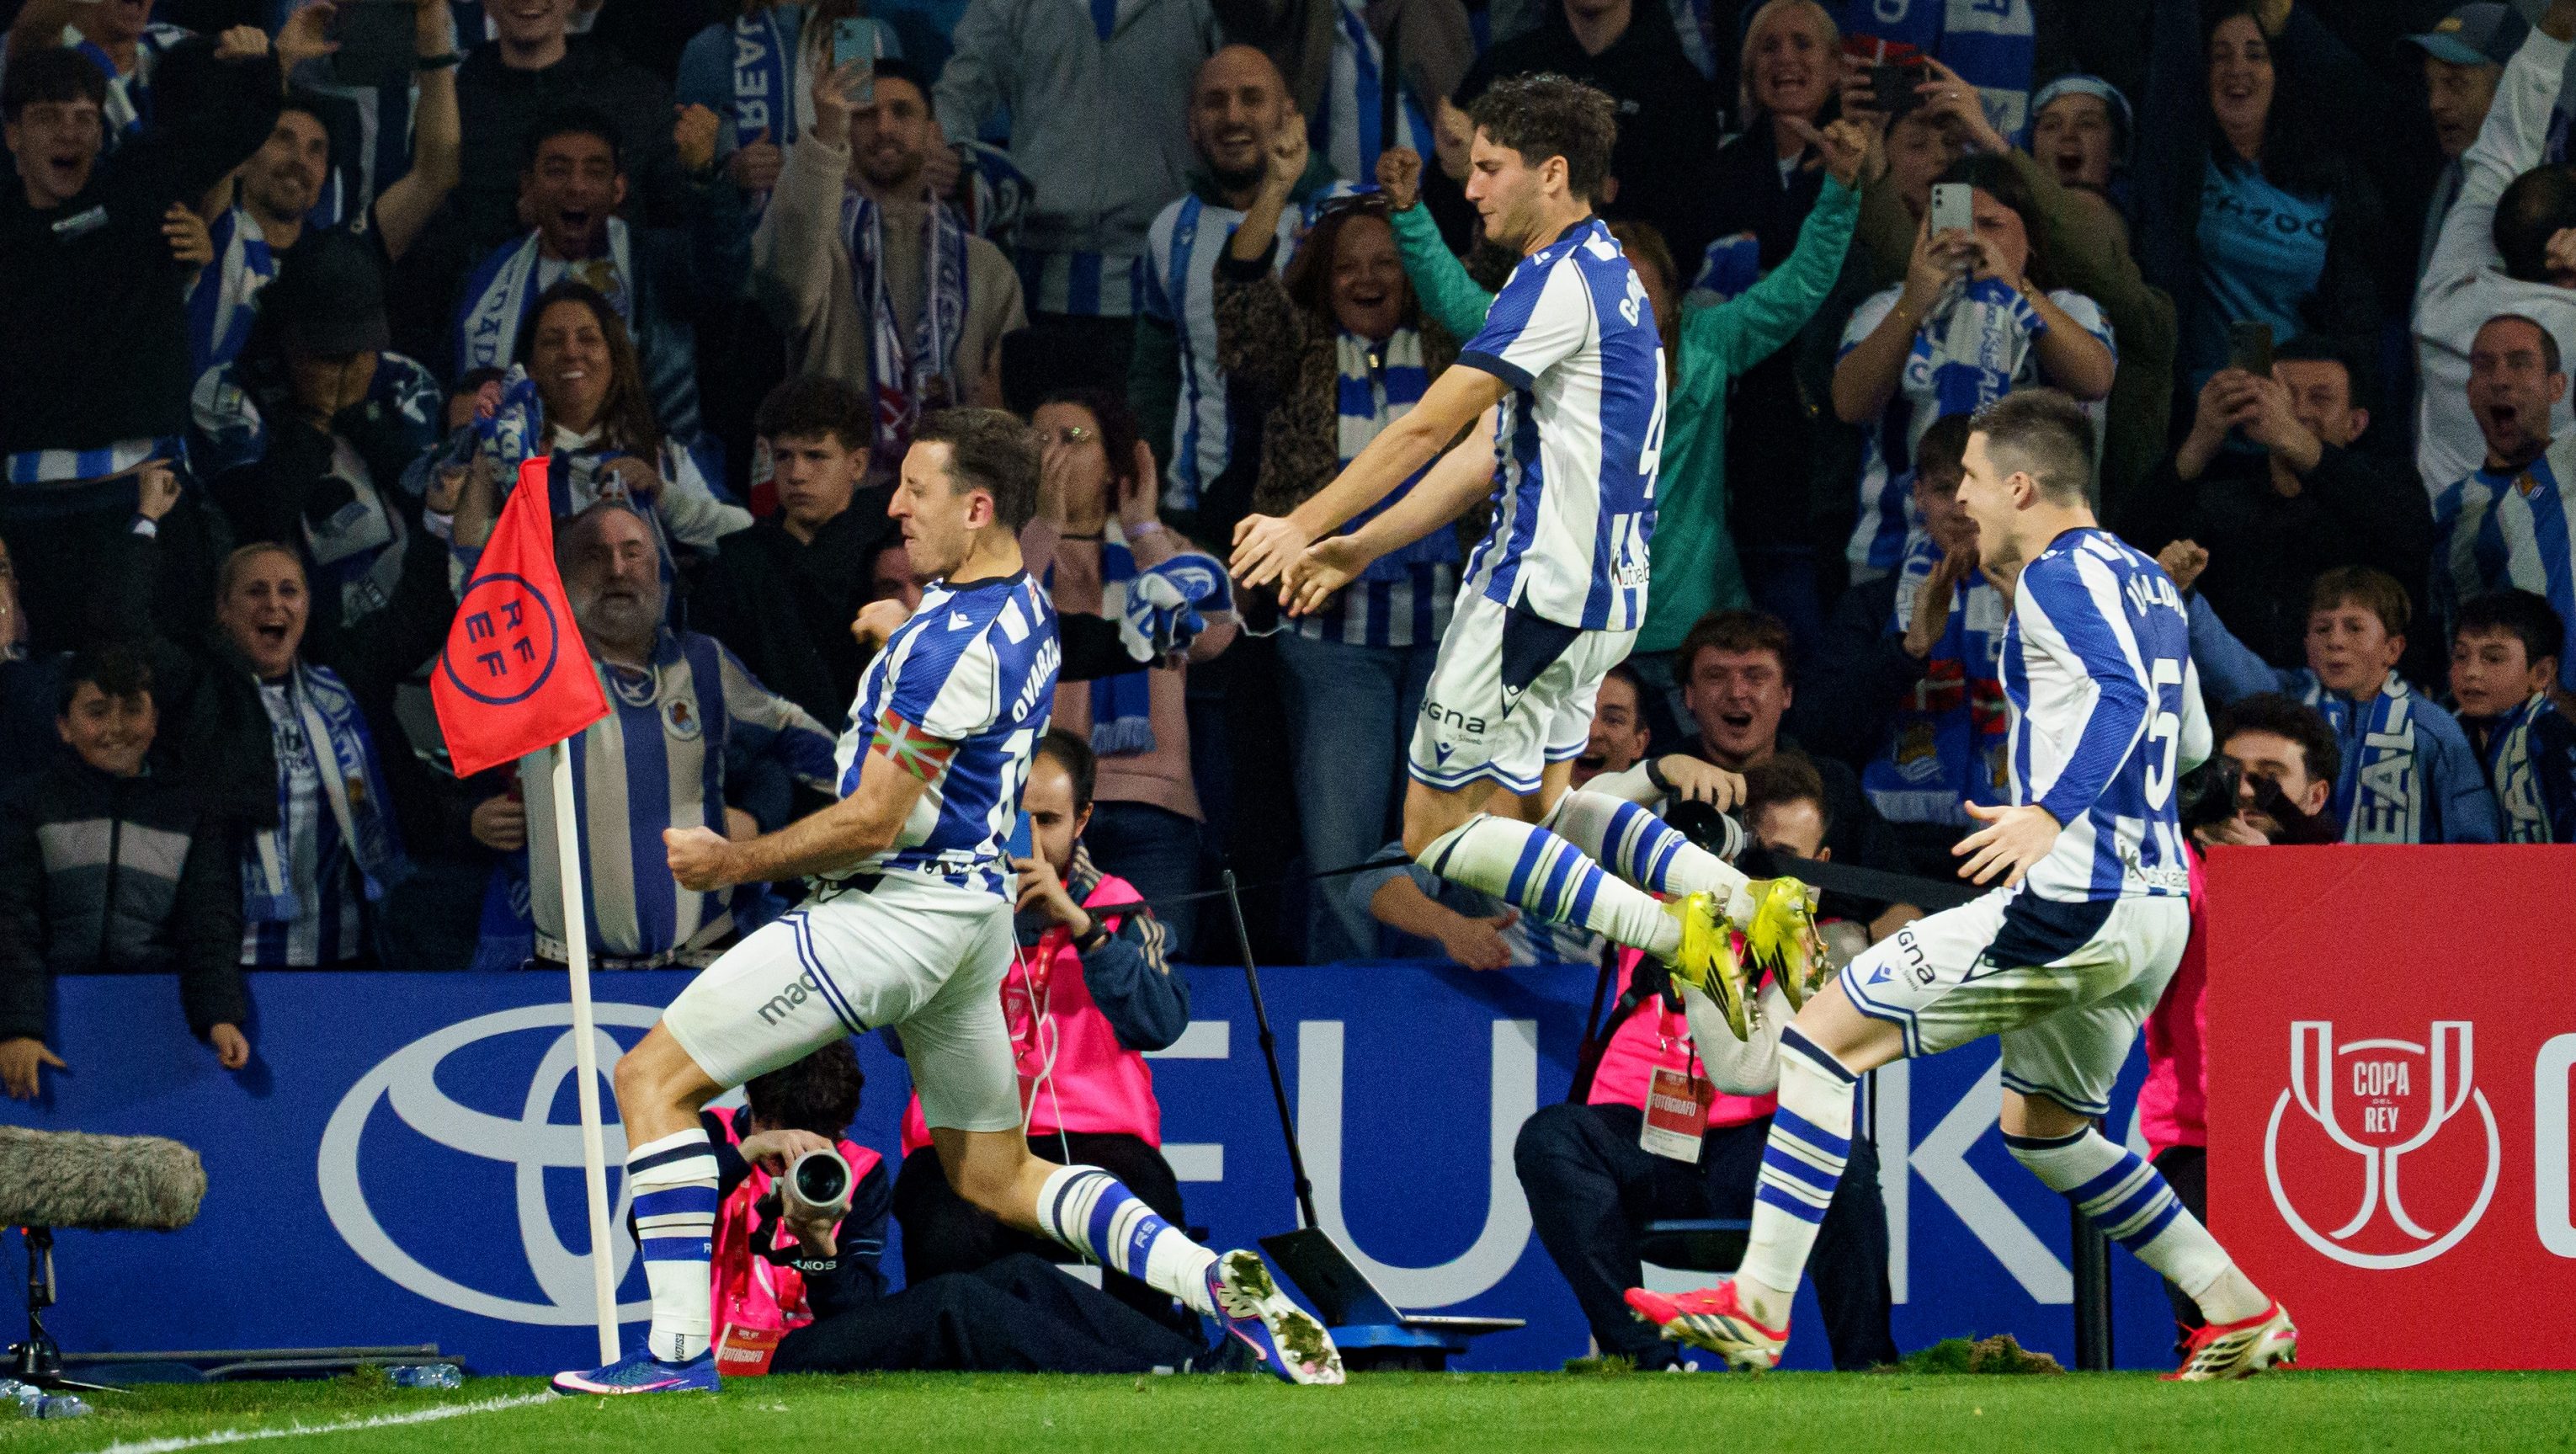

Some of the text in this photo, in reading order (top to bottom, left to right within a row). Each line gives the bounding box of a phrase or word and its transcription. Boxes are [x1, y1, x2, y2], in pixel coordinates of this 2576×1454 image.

[2144, 658, 2182, 812] 5
[2354, 1061, 2410, 1096] COPA
[2365, 1106, 2399, 1132] REY
[1134, 1221, 1158, 1249] RS
